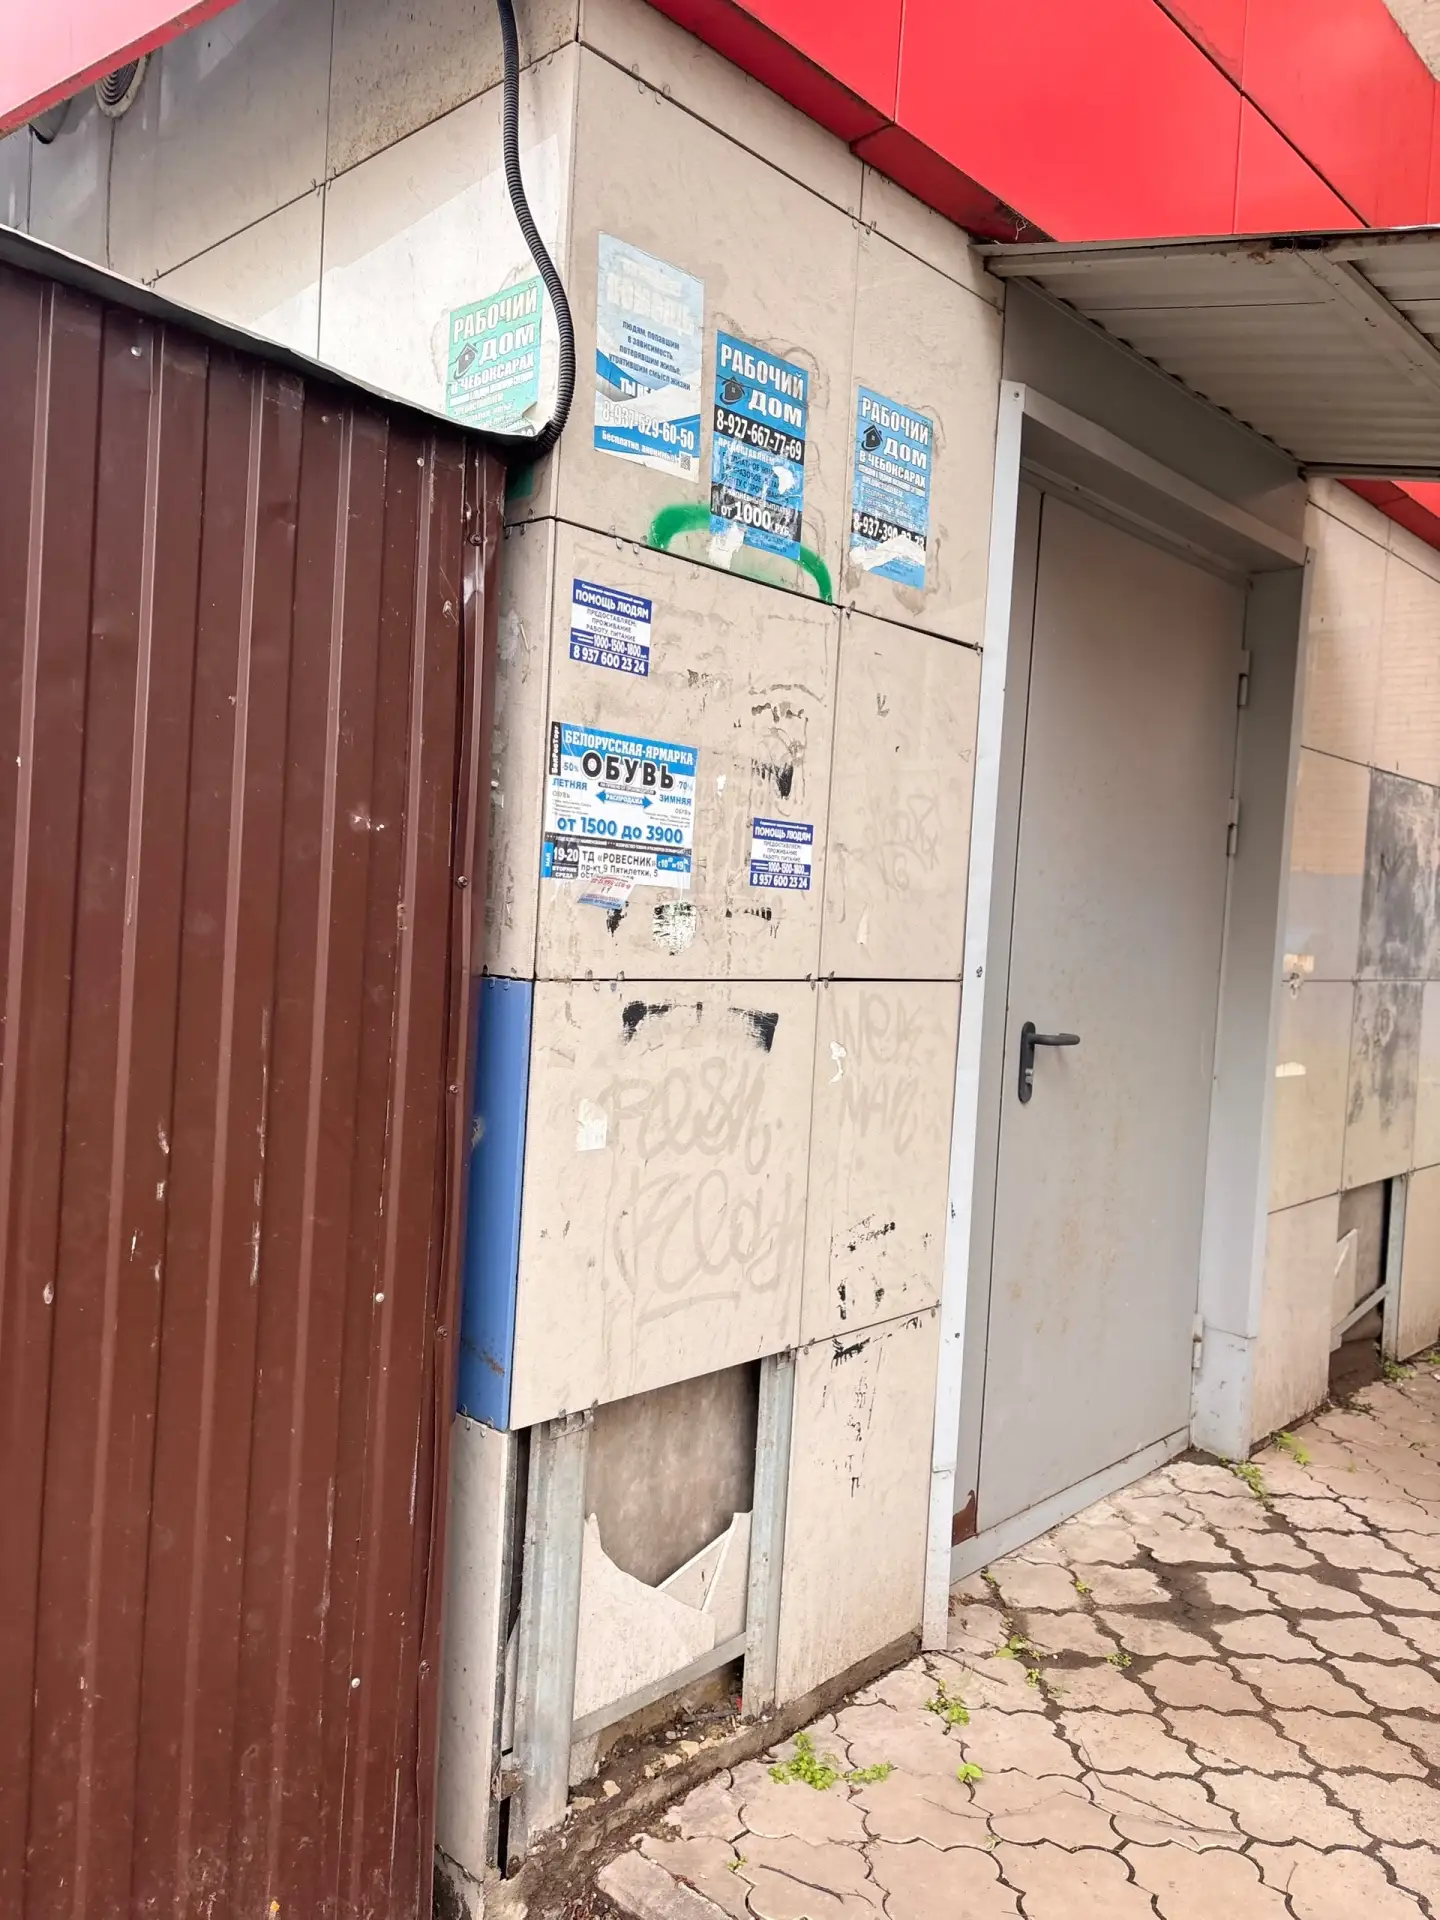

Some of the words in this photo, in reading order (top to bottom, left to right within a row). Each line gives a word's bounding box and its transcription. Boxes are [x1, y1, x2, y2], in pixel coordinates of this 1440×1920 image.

[453, 281, 538, 344] РАБОЧИЙ
[478, 323, 536, 366] ДОМ
[460, 352, 535, 392] ЧЕБОКСАРАХ
[721, 343, 804, 400] РАБОЧИЙ
[748, 389, 802, 428] ДОМ
[862, 397, 929, 446] РАБОЧИЙ
[602, 400, 695, 450] 8-937-529-60-50
[717, 409, 802, 461] 8-927-667-77-69
[859, 450, 866, 463] В
[868, 454, 926, 489] ЧЕБОКСАРАХ
[884, 438, 927, 470] ДОМ
[734, 501, 772, 530] 1000
[576, 589, 616, 611] ПОМОЩЬ
[617, 600, 649, 620] ЛЮДЯМ
[573, 645, 581, 659] 8
[582, 647, 600, 663] 937
[600, 652, 620, 668] 600
[621, 657, 633, 671] 23
[633, 660, 646, 674] 24
[552, 778, 588, 790] ЛЕТНЯЯ
[582, 751, 674, 789] ОБУВЬ
[659, 794, 692, 806] ЗИМНЯЯ
[557, 817, 577, 832] от
[580, 816, 617, 837] 1500
[621, 825, 642, 841] до
[646, 825, 683, 845] 3900
[755, 826, 786, 839] ПОМОЩЬ
[786, 830, 812, 842] ЛЮДЯМ
[554, 848, 578, 863] 19-20
[582, 851, 595, 863] ТД
[597, 854, 656, 868] «РОВЕСНИК»
[603, 864, 608, 872] 9
[610, 866, 651, 879] Пятилетки,
[653, 869, 658, 878] 5
[752, 873, 758, 885] 8
[773, 875, 788, 886] 600
[788, 876, 798, 888] 23
[798, 877, 808, 888] 24
